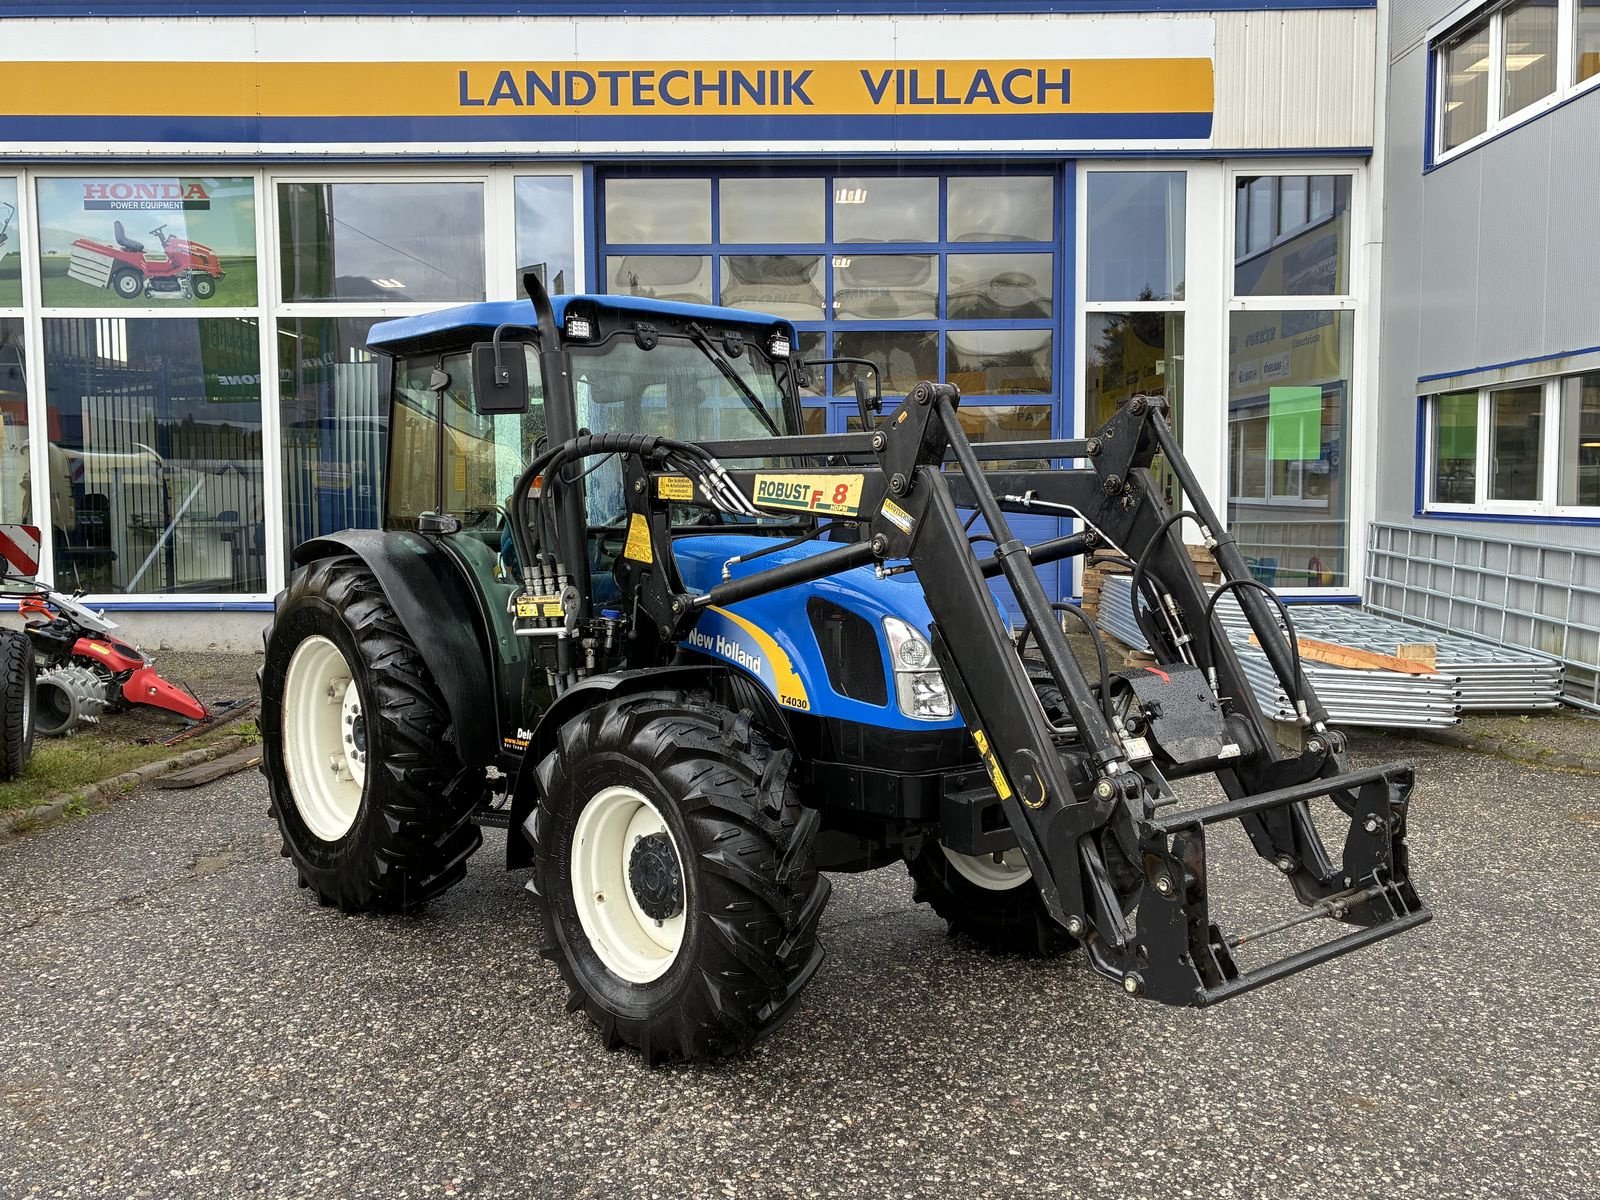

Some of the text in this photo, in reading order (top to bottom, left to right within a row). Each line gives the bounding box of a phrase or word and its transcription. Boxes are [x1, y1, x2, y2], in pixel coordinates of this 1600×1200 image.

[458, 68, 1071, 106] LANDTECHNIK VILLACH
[83, 183, 210, 199] HONDA
[110, 201, 184, 209] POWER EQUIPMENT
[758, 480, 848, 509] ROBUST F 8
[688, 627, 762, 675] New Holland
[780, 694, 808, 709] T4030
